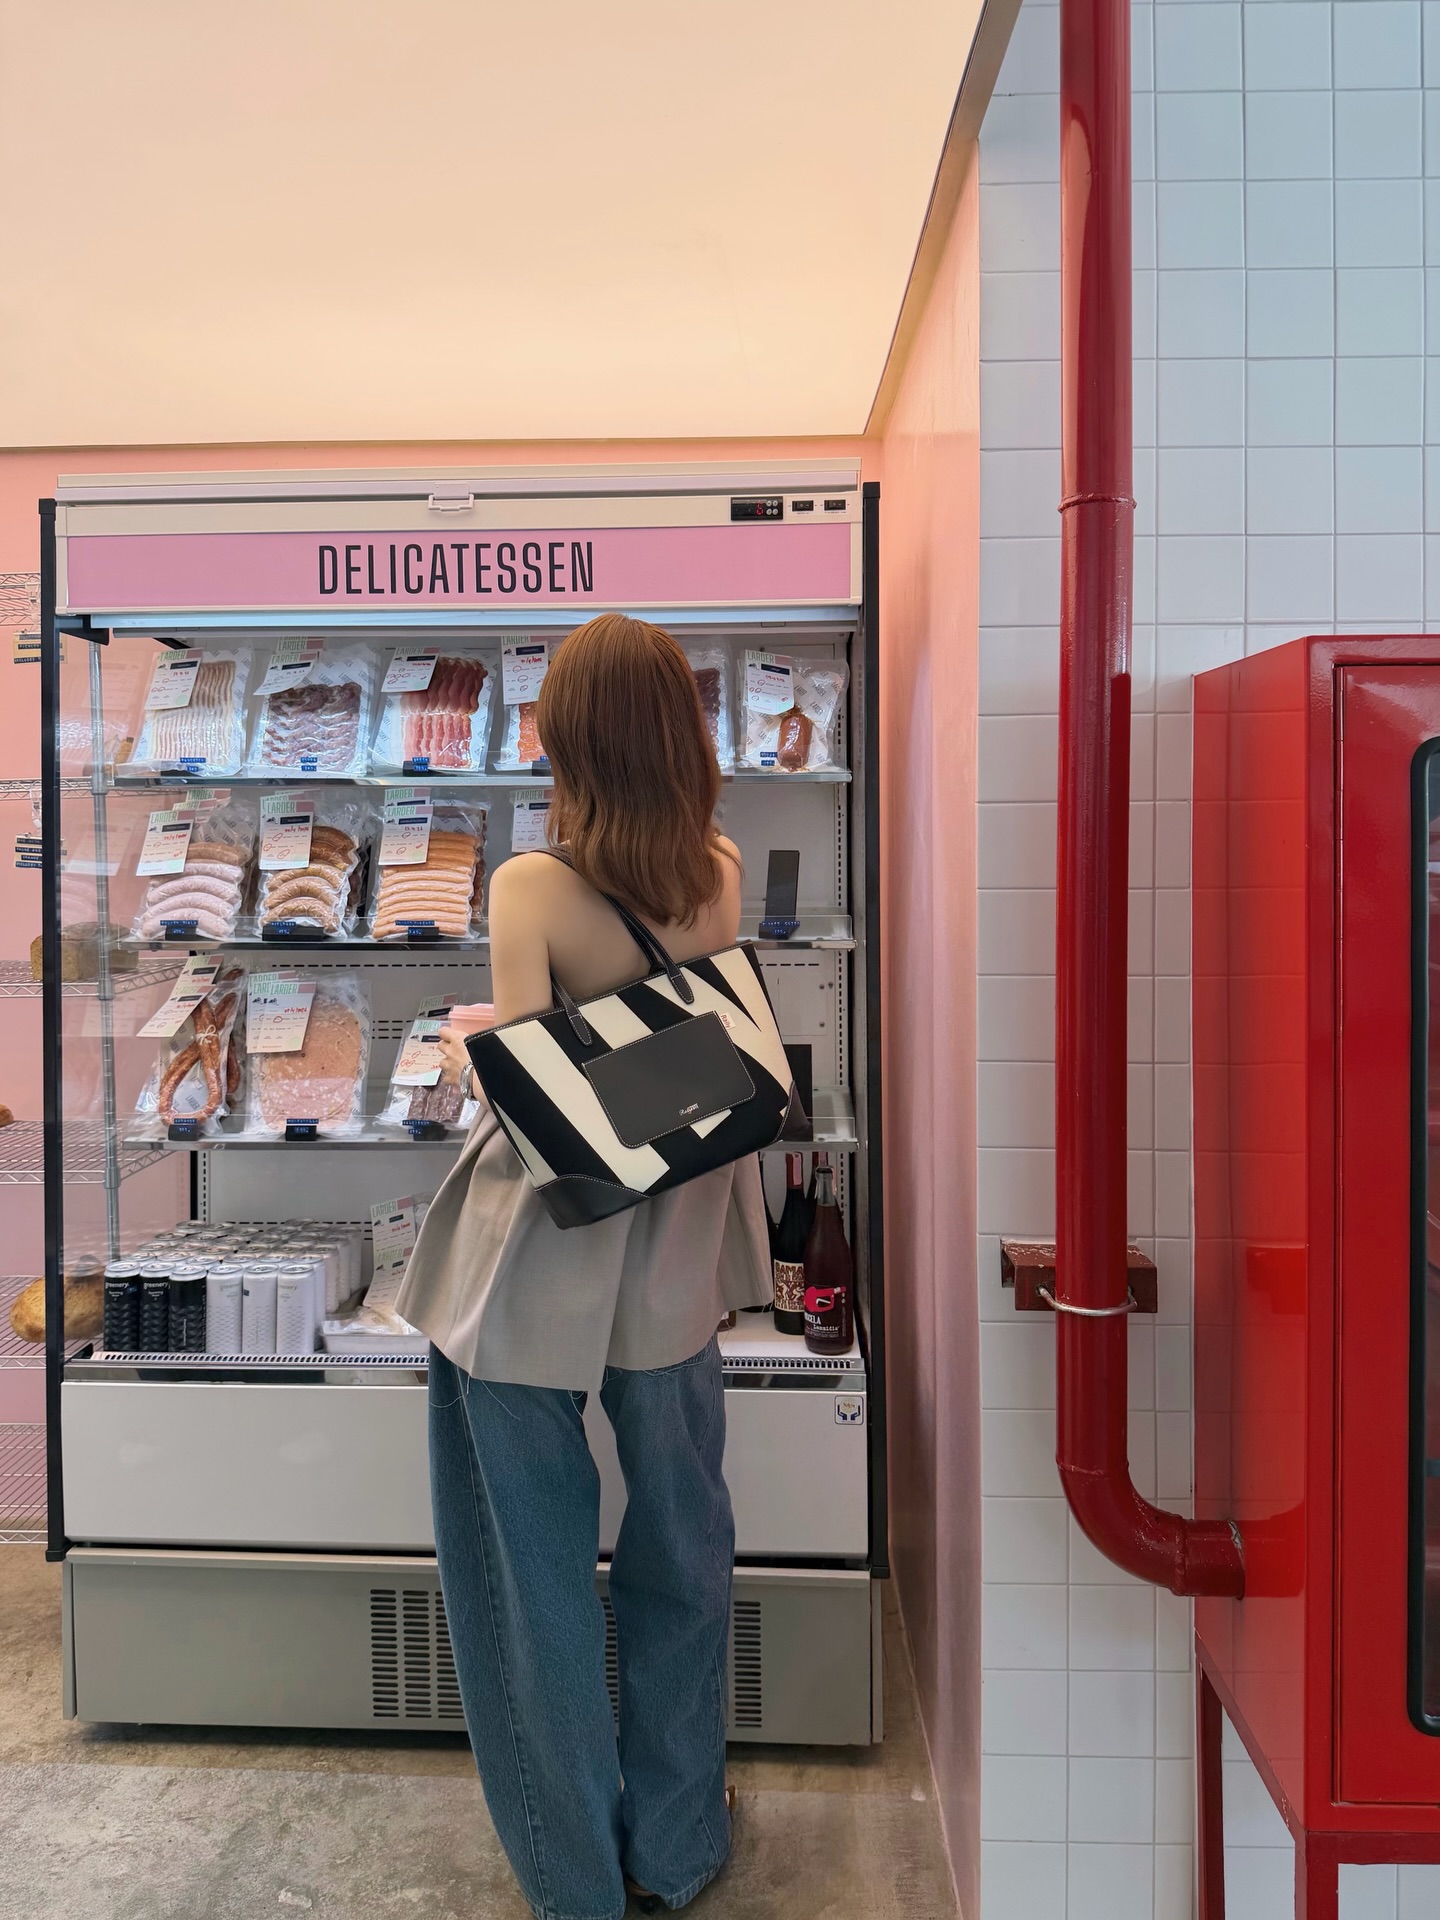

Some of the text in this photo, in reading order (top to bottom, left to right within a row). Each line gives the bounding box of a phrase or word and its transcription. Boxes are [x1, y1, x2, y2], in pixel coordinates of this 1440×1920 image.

[319, 542, 593, 595] DELICATESSEN
[279, 640, 306, 651] LARDER
[161, 650, 186, 661] LARDER
[271, 654, 298, 664] LARDER
[747, 651, 775, 664] LARDER
[189, 790, 214, 800] LARDER
[387, 789, 413, 800] LARDER
[517, 790, 543, 801] LARDER
[267, 802, 295, 813] LARDER
[387, 806, 415, 817] LARDER
[151, 810, 177, 824] LARDER
[270, 983, 298, 995] LARDER
[372, 1201, 397, 1218] LARDER
[377, 1249, 403, 1262] LARDER
